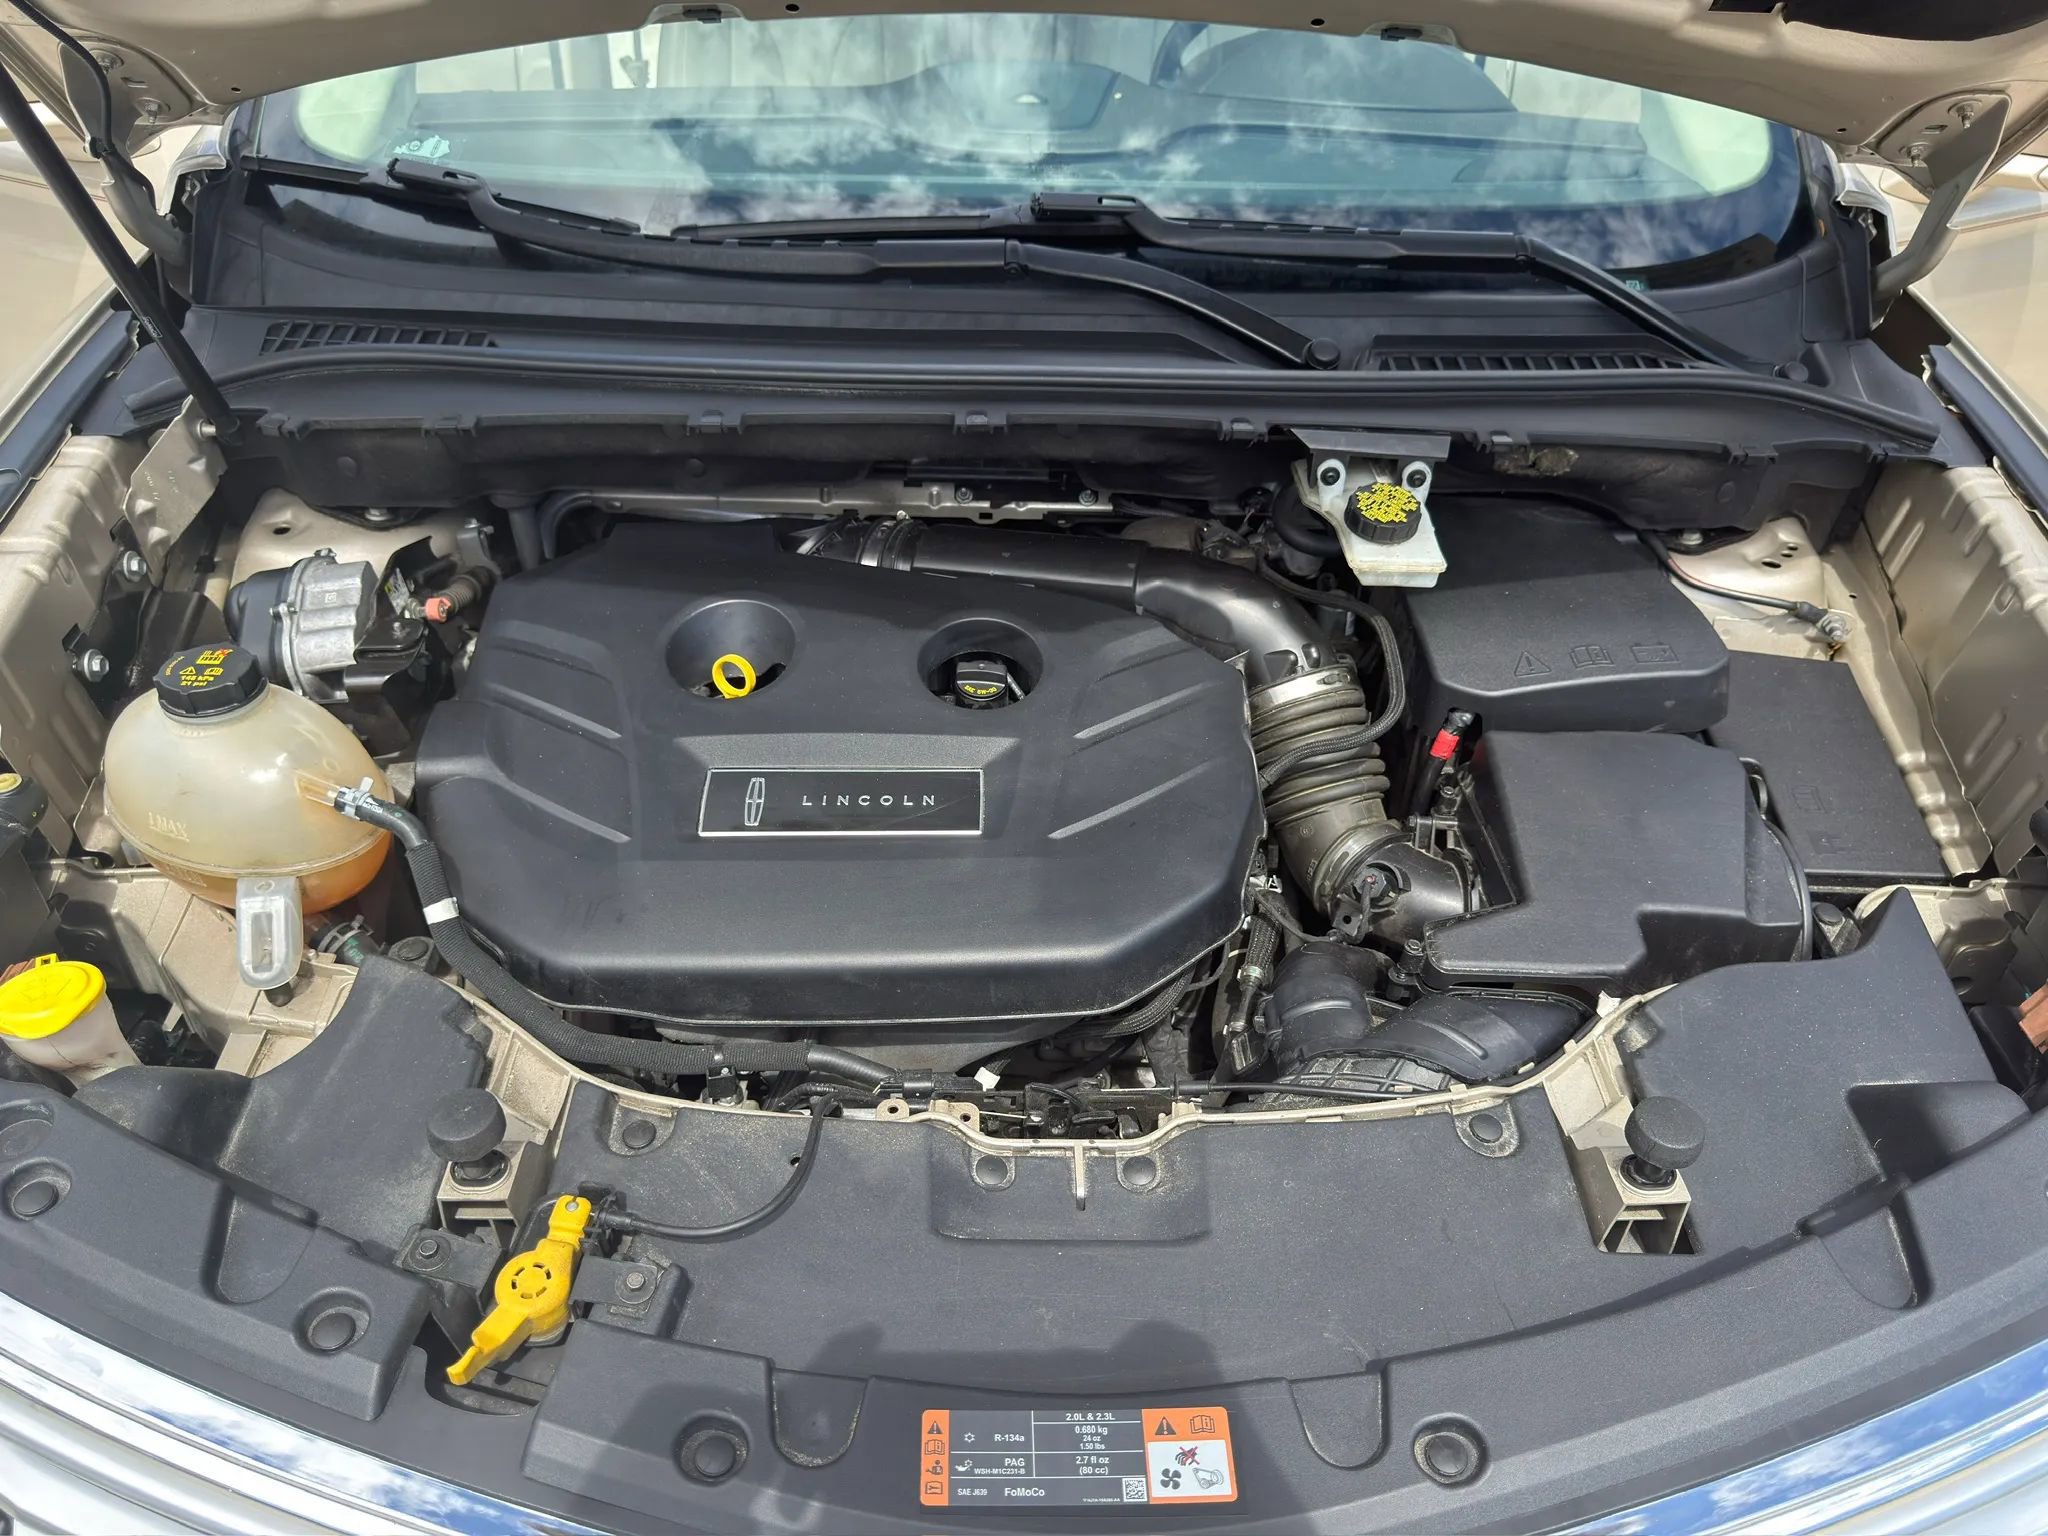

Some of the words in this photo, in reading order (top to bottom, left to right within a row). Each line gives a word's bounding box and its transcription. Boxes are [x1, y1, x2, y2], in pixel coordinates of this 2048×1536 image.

[801, 794, 936, 807] LINCOLN
[1065, 1412, 1086, 1421] 2.0L
[1086, 1412, 1095, 1421] &
[1095, 1412, 1117, 1421] 2.3L
[1074, 1424, 1096, 1434] 0.680
[1097, 1424, 1109, 1436] kg
[994, 1433, 1026, 1442] R-134a
[1082, 1434, 1092, 1442] 24
[1079, 1442, 1094, 1450] 1.50
[1094, 1442, 1106, 1450] lbs
[1004, 1457, 1026, 1467] PAG
[1075, 1455, 1089, 1464] 2.7
[1090, 1455, 1098, 1464] fl
[1079, 1466, 1093, 1476] (80
[1094, 1466, 1109, 1476] cc)
[957, 1488, 972, 1496] SAE
[972, 1488, 988, 1496] J639
[1004, 1487, 1046, 1497] FoMoCo
